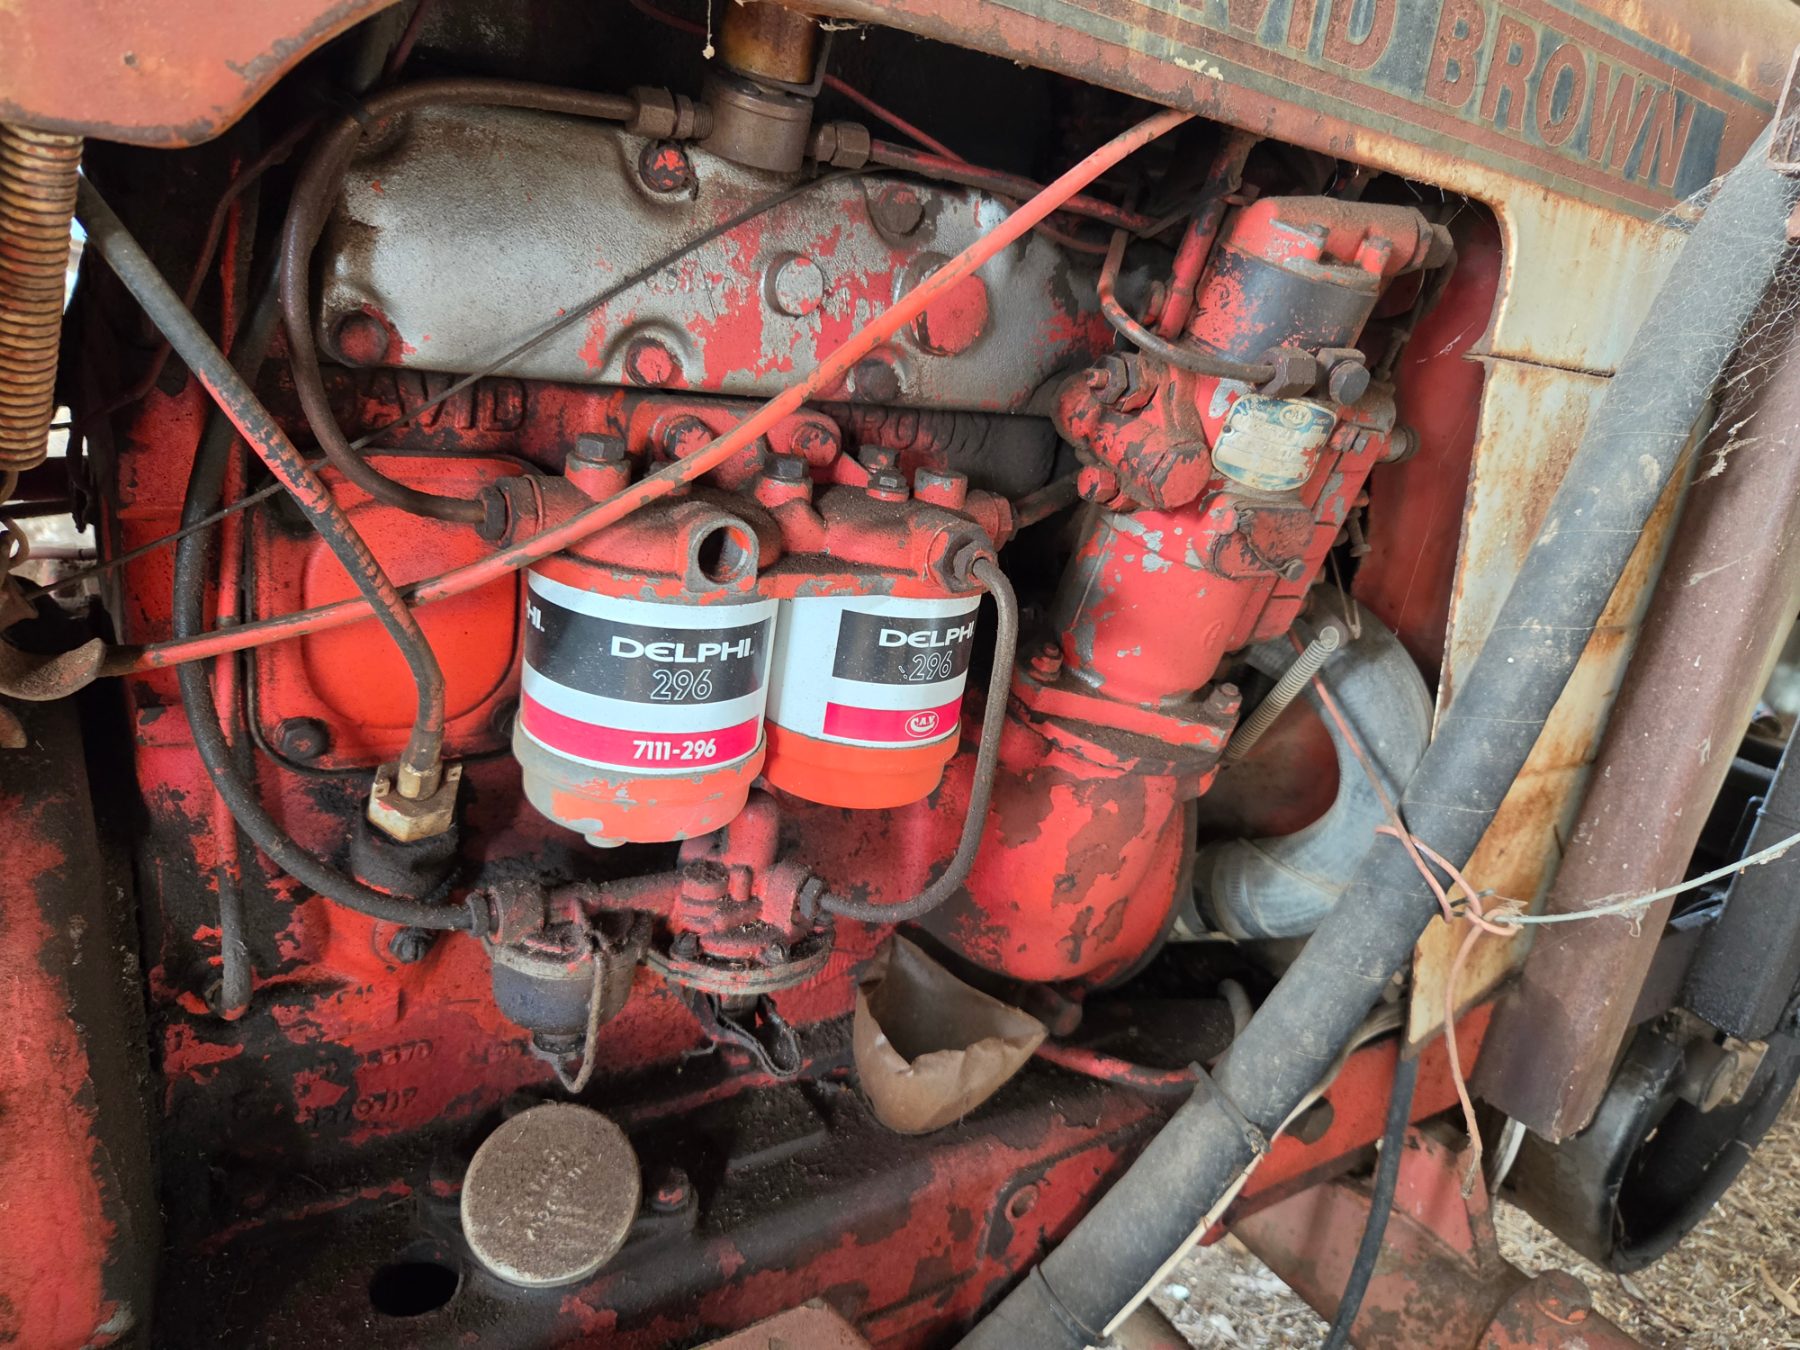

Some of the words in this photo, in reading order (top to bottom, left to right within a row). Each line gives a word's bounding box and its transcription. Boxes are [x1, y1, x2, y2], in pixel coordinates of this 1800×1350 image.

[1423, 0, 1696, 188] BROWN
[879, 621, 975, 648] DELPHI
[611, 636, 752, 663] DELPHI
[908, 651, 952, 681] 296
[650, 669, 713, 700] 296
[633, 738, 717, 760] 7111-296
